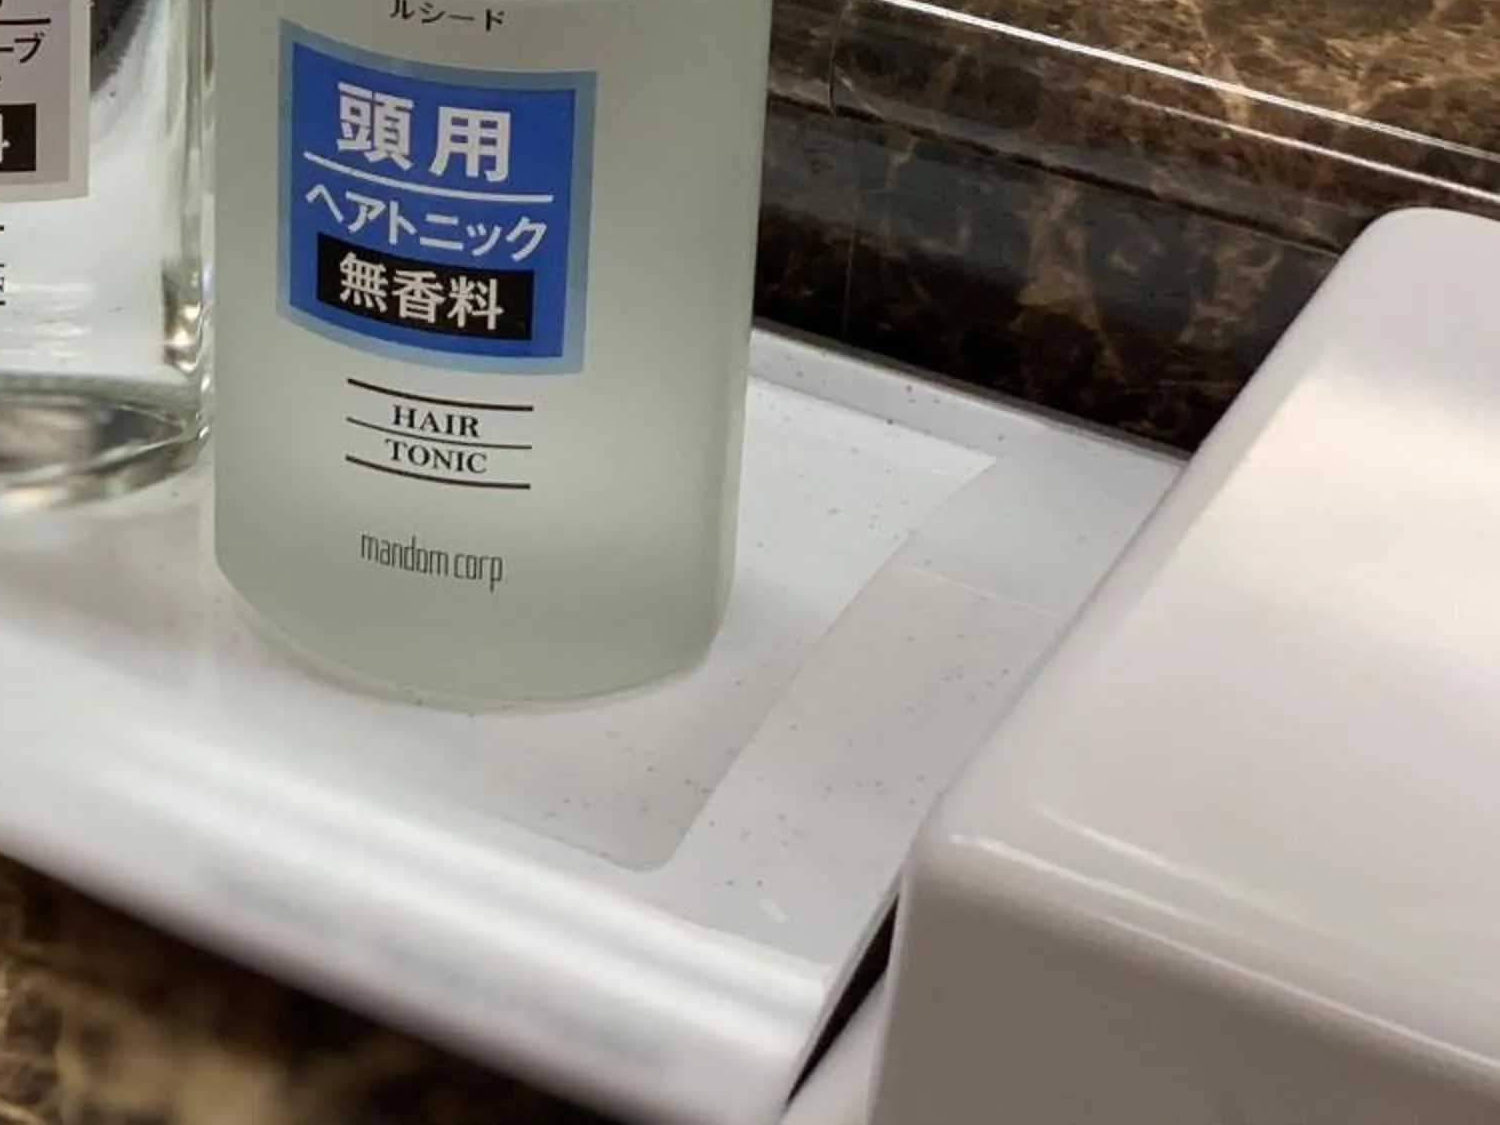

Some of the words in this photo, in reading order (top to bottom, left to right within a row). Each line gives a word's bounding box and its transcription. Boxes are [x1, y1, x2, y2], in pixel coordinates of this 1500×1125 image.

[337, 81, 511, 183] 頭用
[305, 183, 548, 262] ヘアトニック
[340, 252, 504, 330] 無香料
[393, 404, 480, 438] HAIR
[385, 438, 488, 474] TONIC
[360, 534, 449, 576] mandom
[453, 553, 503, 593] corp
